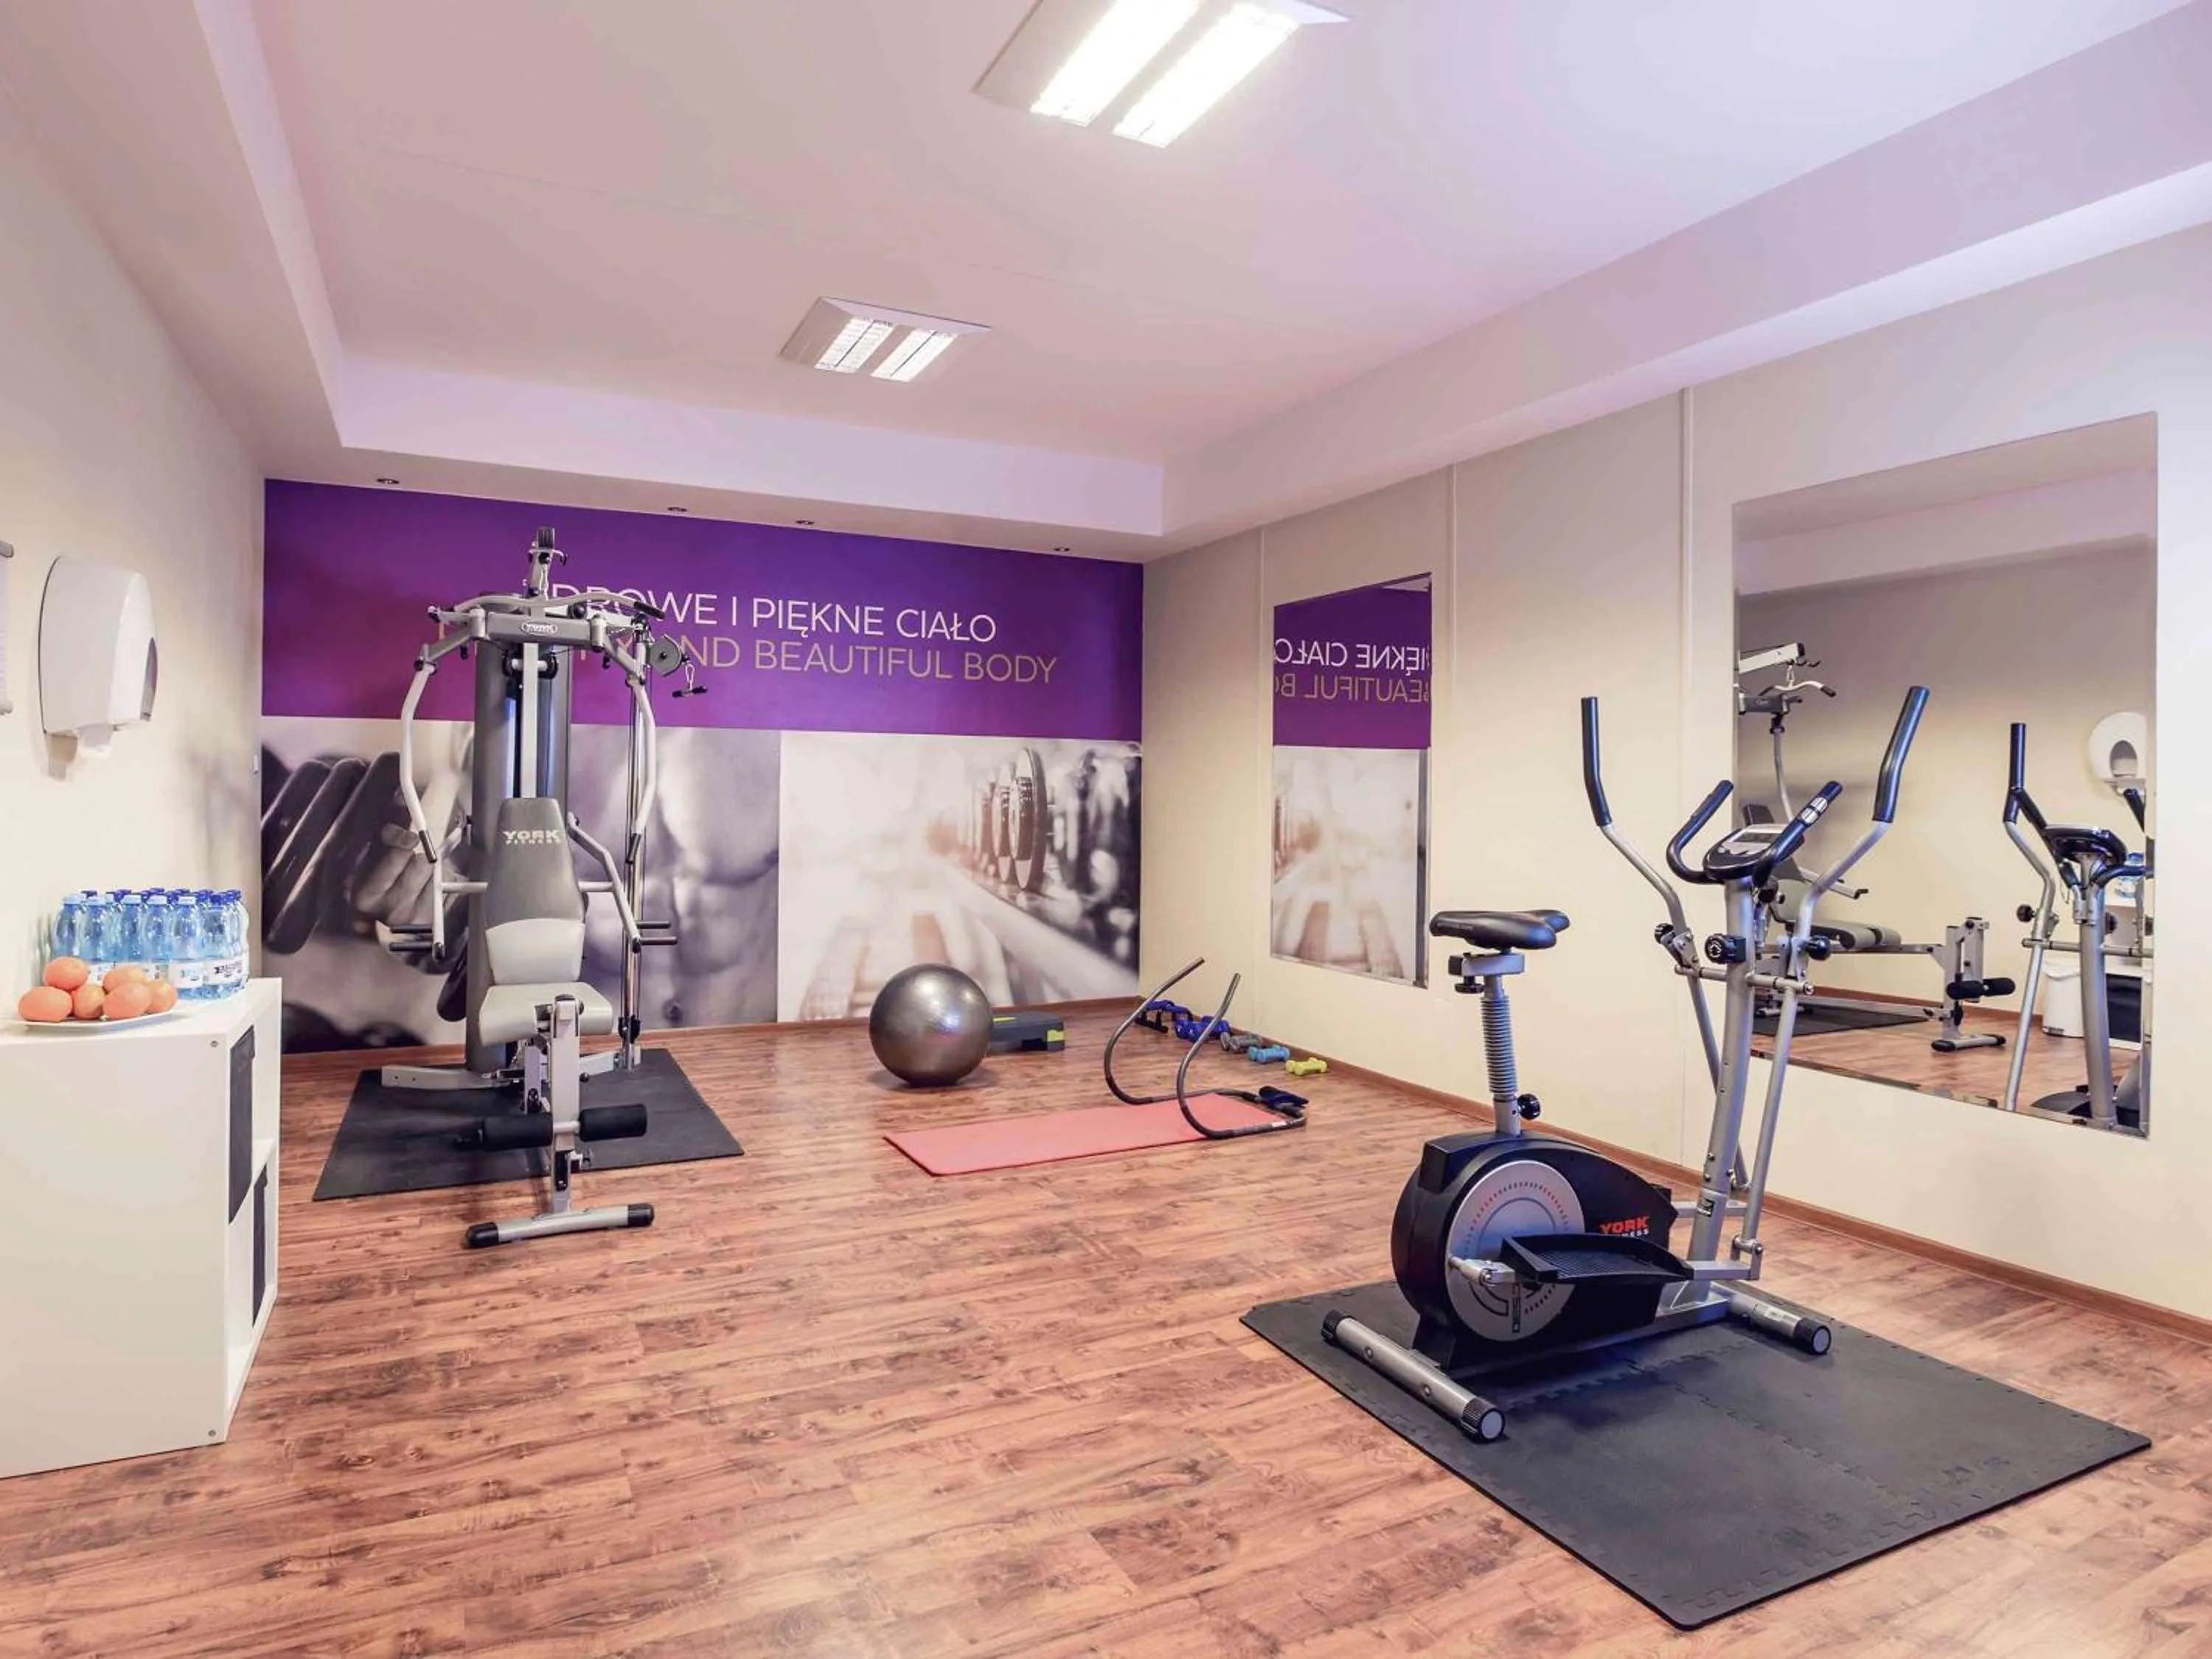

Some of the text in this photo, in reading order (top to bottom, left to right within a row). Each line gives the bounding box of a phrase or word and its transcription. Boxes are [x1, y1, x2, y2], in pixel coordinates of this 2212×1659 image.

[552, 582, 996, 642] ROWE I PIĘKNE CIAŁO
[680, 634, 1057, 684] ND BEAUTIFUL BODY
[502, 830, 561, 840] YORK
[1600, 1217, 1649, 1234] YORK
